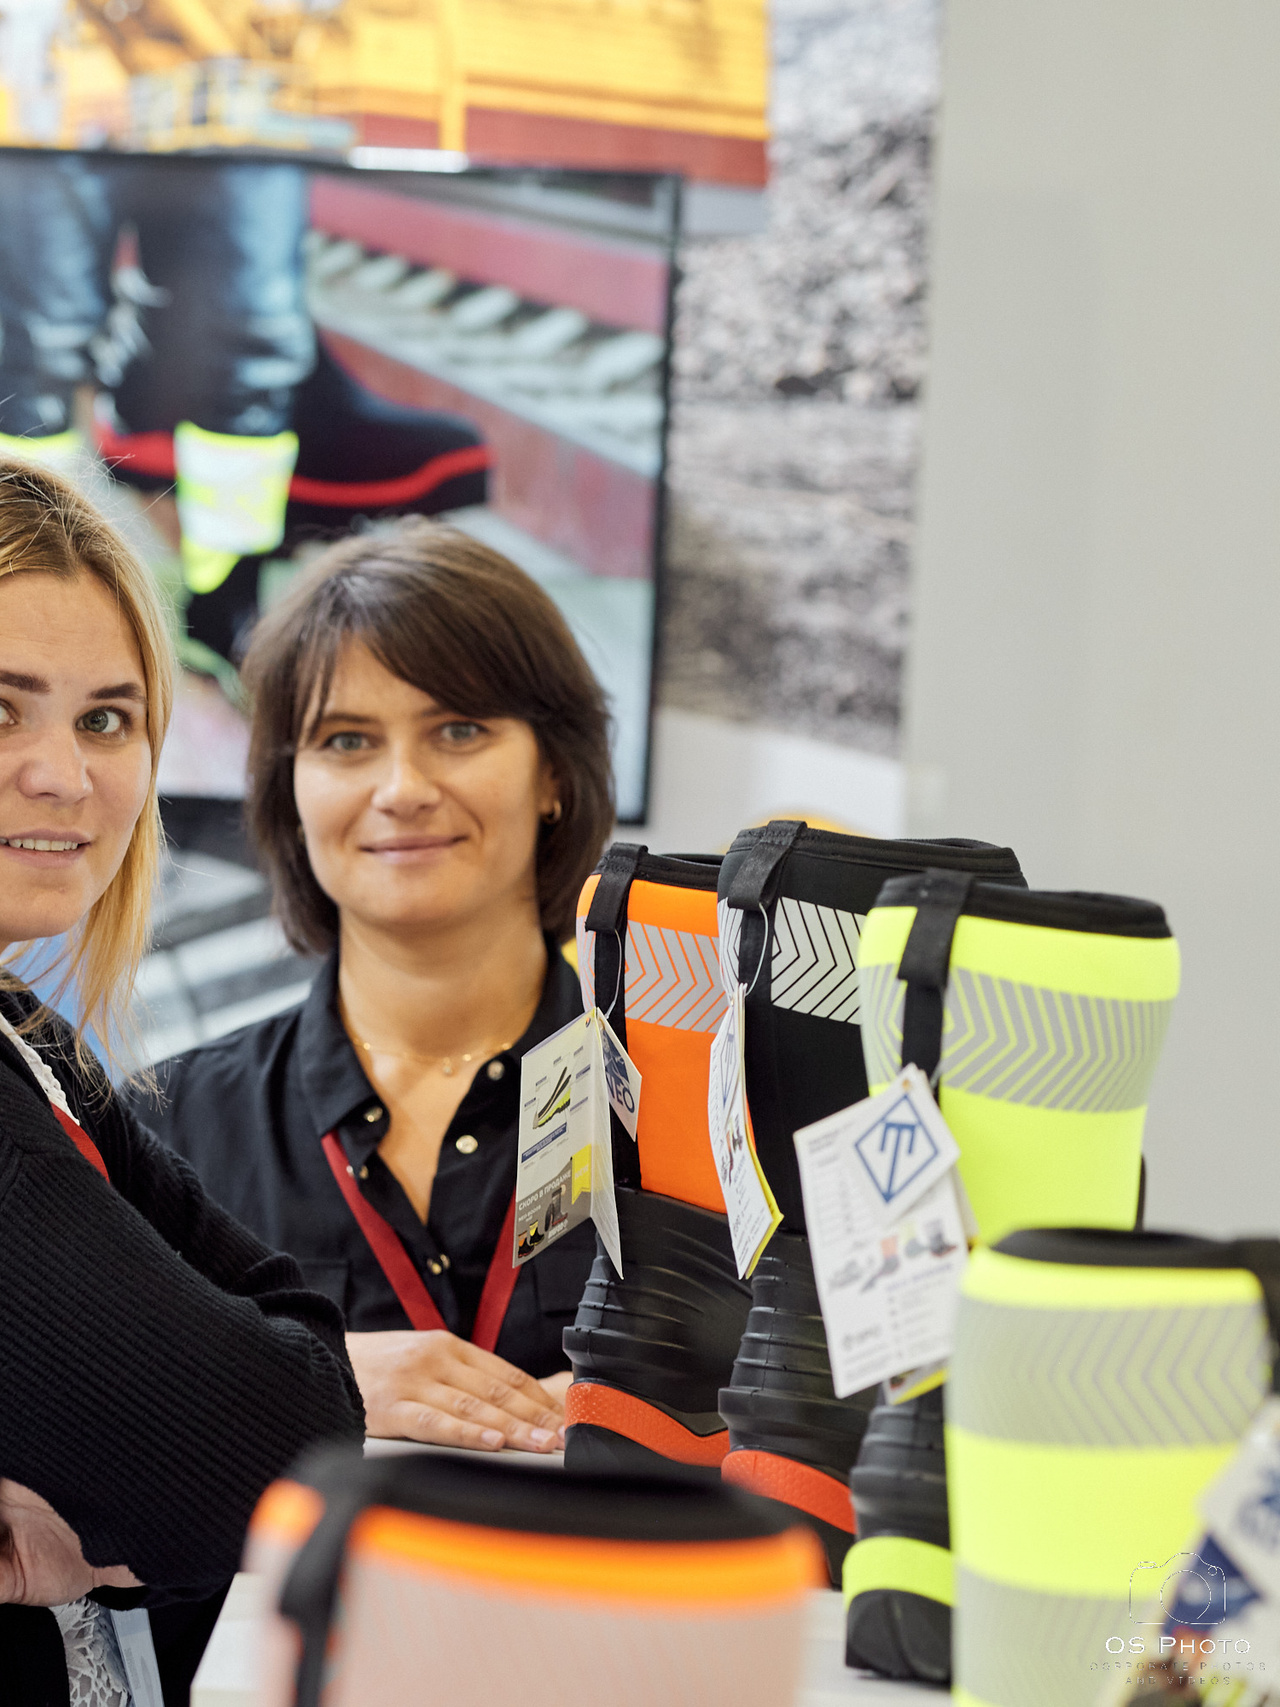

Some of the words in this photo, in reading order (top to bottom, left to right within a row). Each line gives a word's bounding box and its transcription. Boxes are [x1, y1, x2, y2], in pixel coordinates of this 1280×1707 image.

[606, 1073, 635, 1114] NEO
[518, 1193, 539, 1211] СКОРО
[544, 1169, 572, 1195] ПРОДАЖЕ
